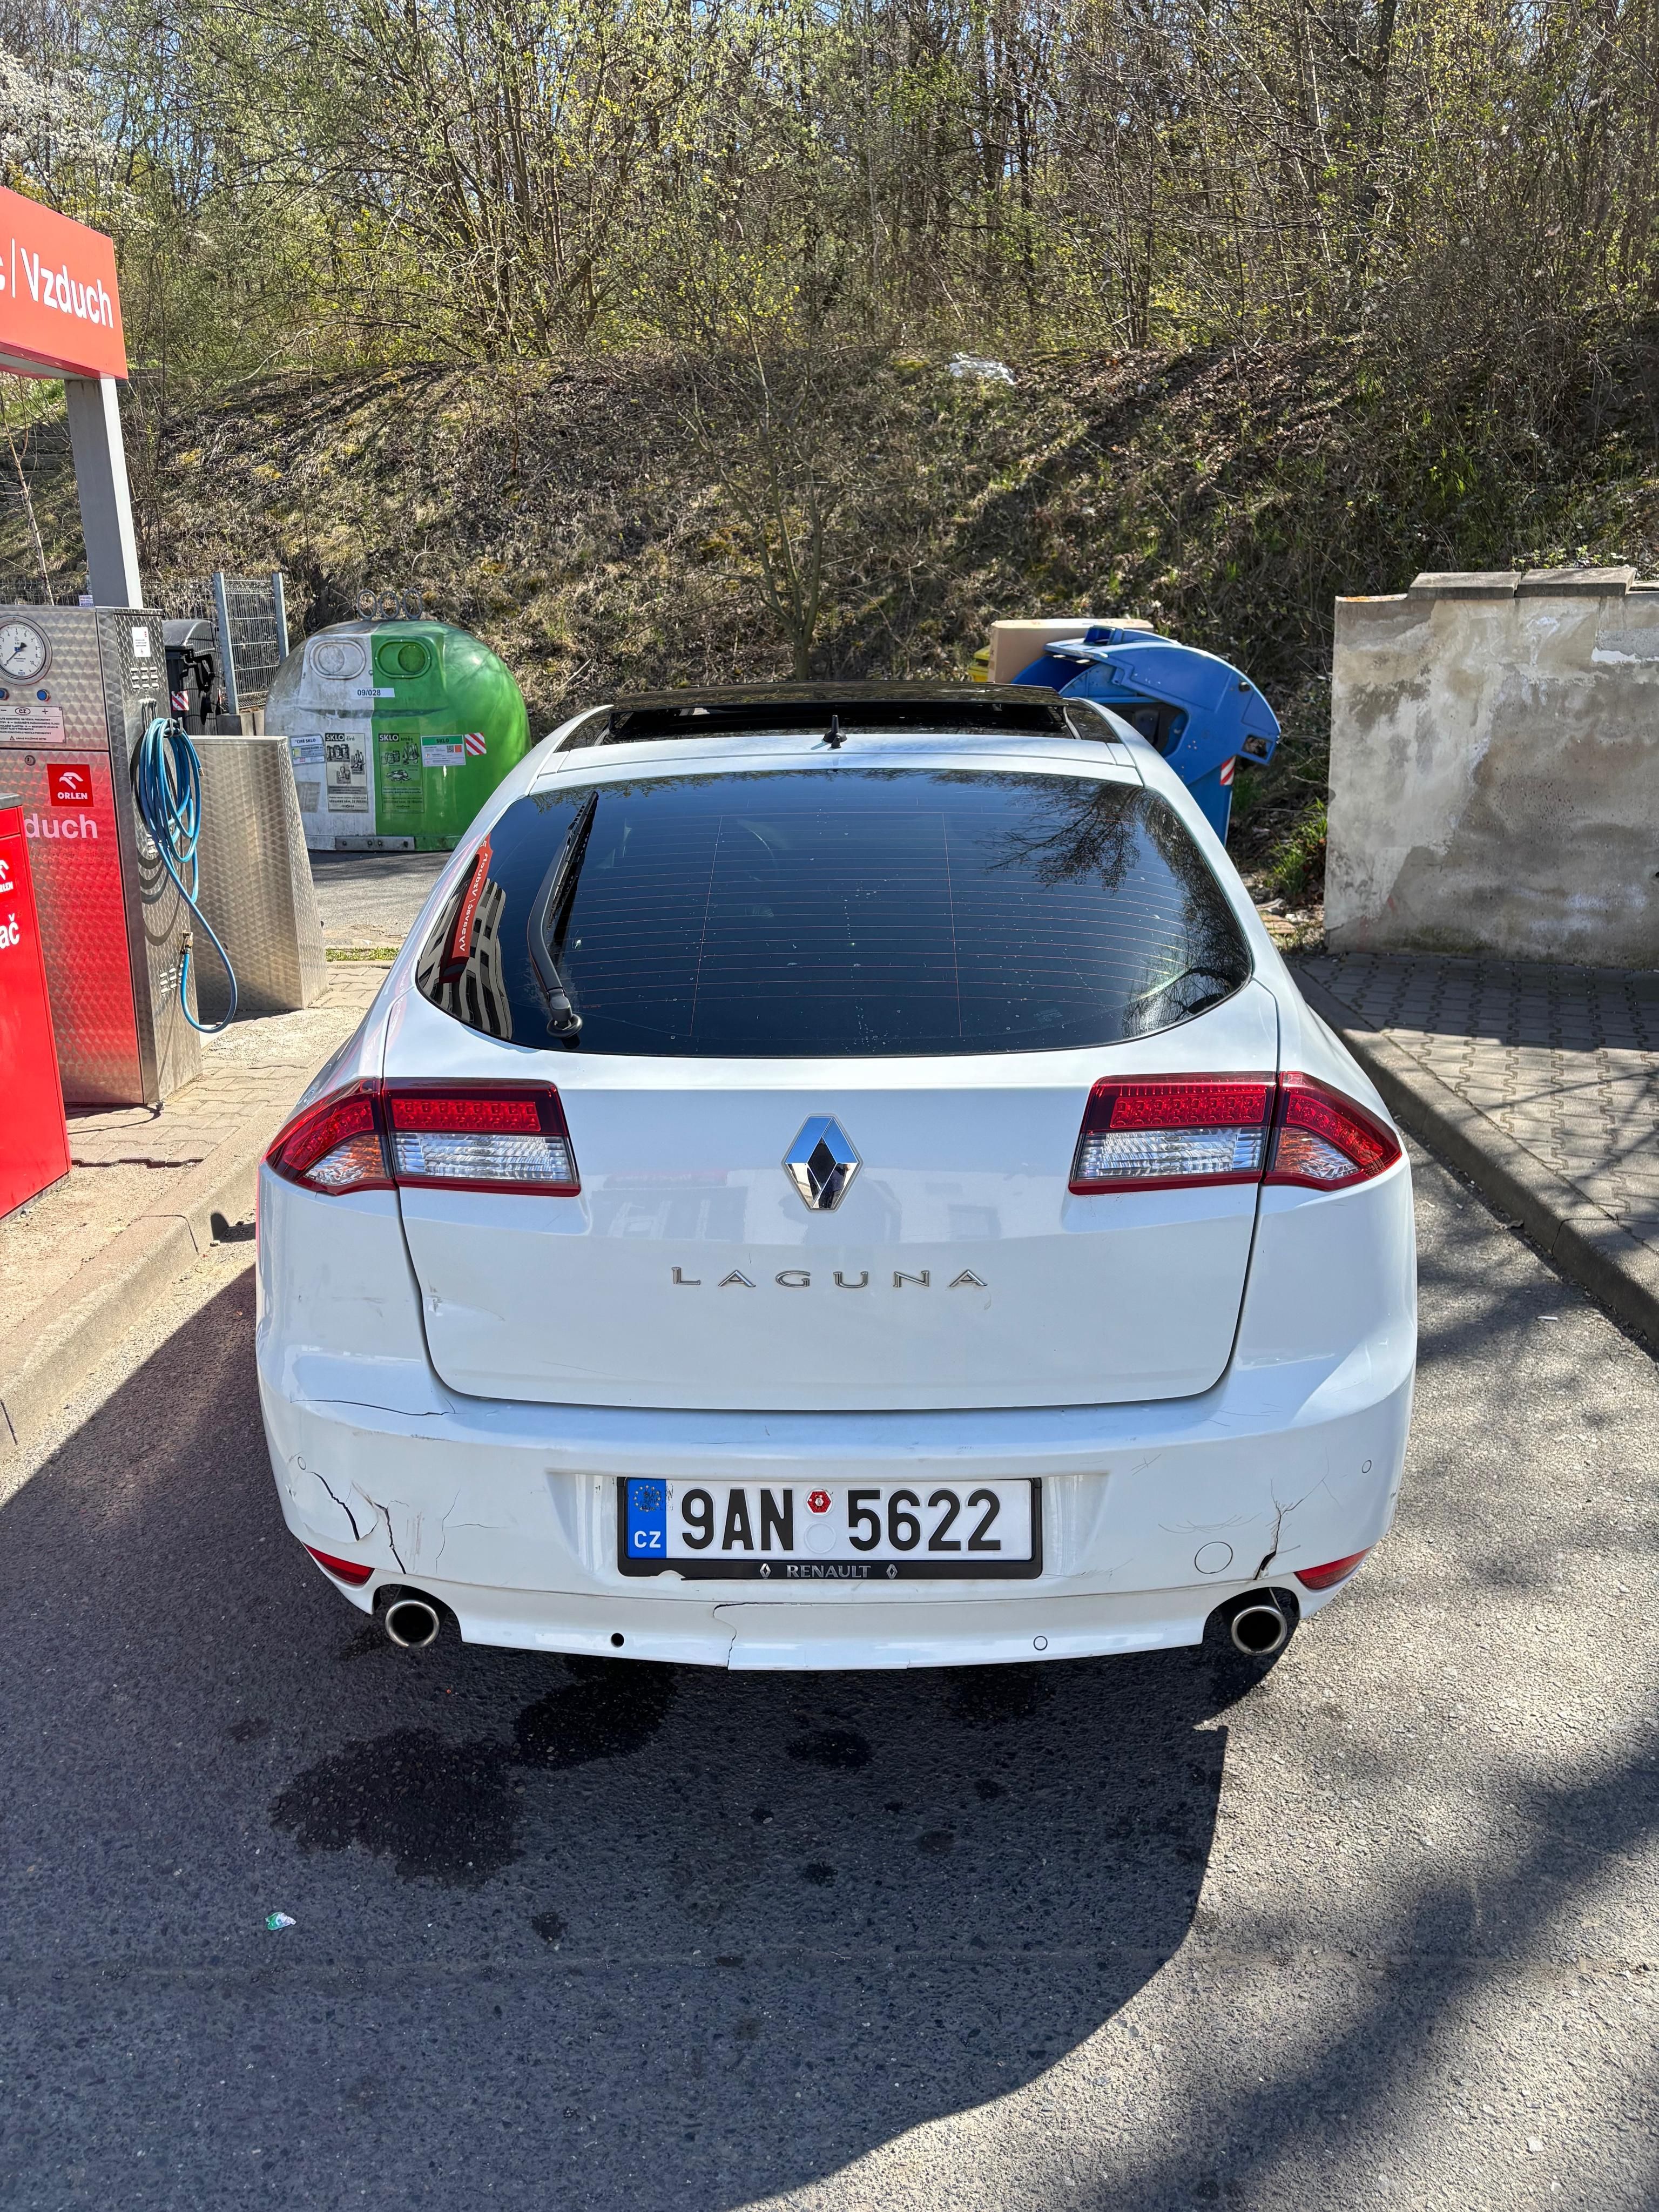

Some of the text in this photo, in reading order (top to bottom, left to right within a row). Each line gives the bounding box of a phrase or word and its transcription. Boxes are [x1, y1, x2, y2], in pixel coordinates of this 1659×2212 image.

[20, 247, 114, 328] Vzduch
[57, 792, 88, 800] ORLEN
[671, 1266, 988, 1289] LAGUNA
[680, 1488, 1001, 1552] 9AN 5622
[633, 1530, 661, 1549] CZ
[786, 1564, 871, 1578] RENAULT
